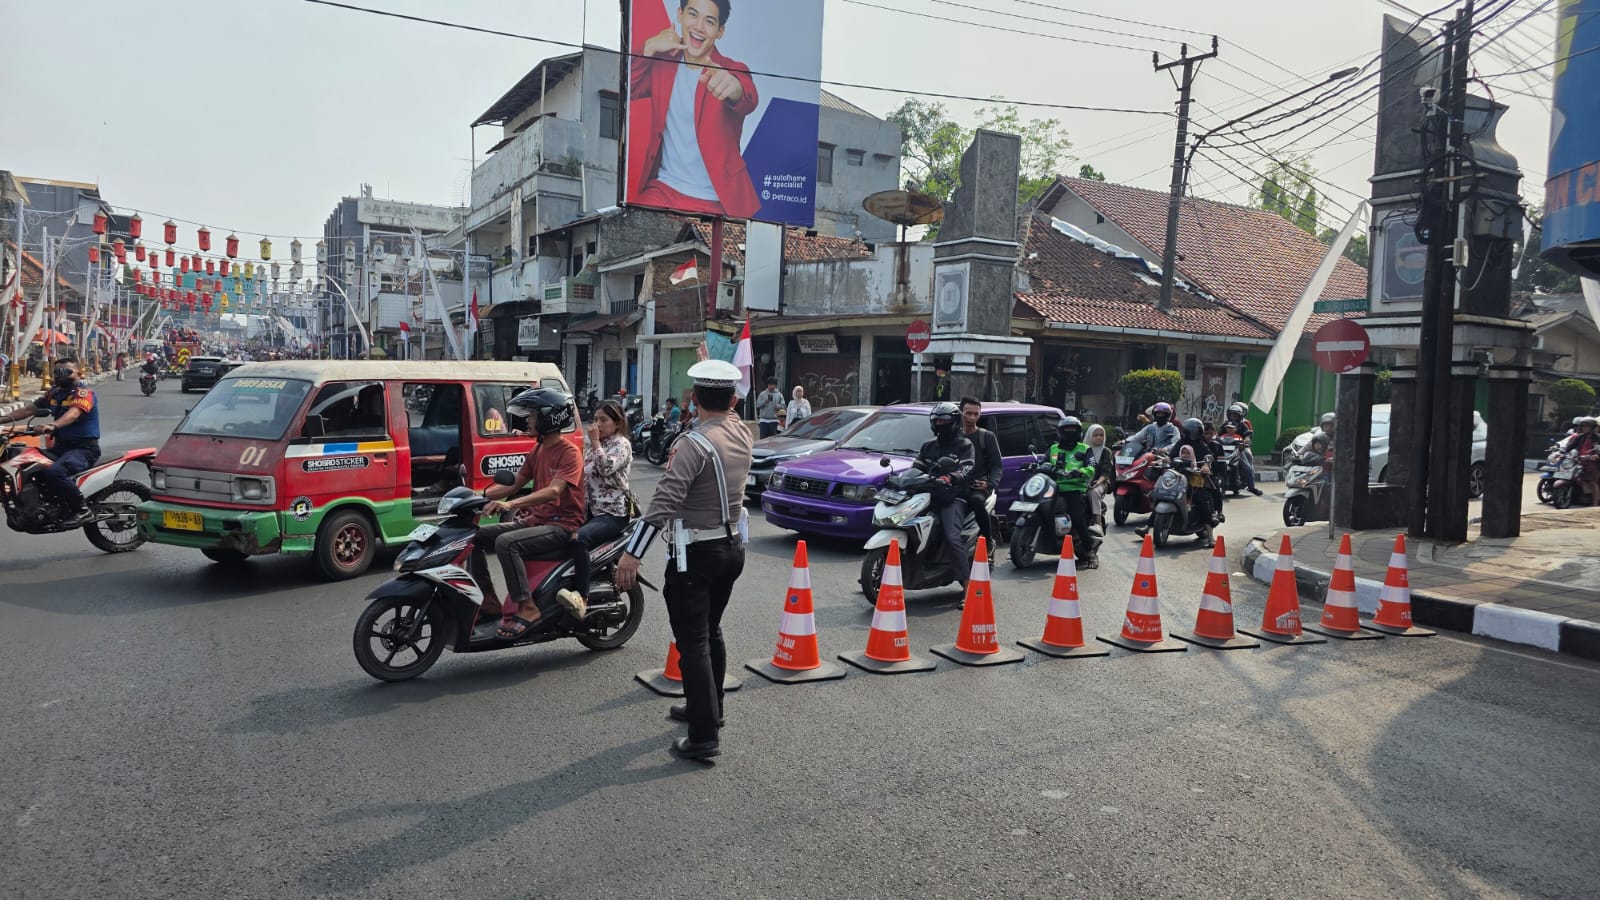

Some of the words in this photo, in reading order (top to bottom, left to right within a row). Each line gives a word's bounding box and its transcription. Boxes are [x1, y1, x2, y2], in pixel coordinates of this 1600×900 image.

[772, 193, 807, 203] petraco.id
[485, 419, 502, 431] 01
[240, 446, 268, 467] 01
[488, 455, 526, 468] SHOSRO
